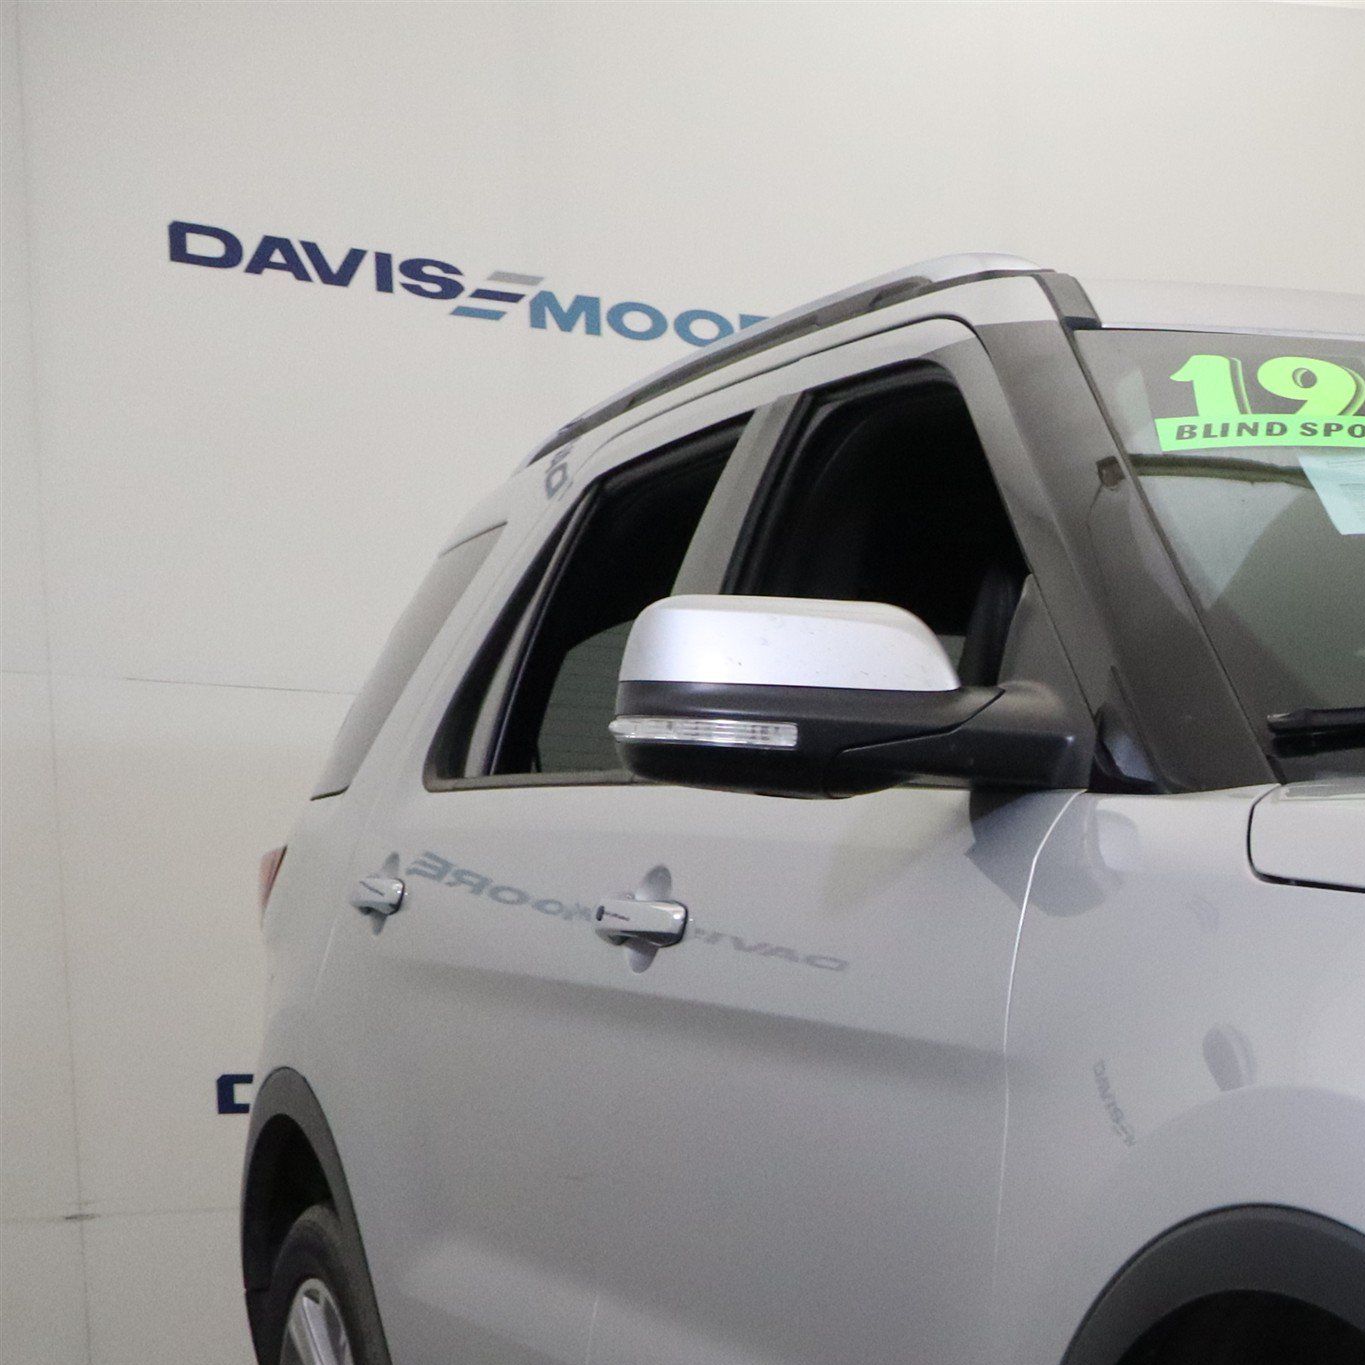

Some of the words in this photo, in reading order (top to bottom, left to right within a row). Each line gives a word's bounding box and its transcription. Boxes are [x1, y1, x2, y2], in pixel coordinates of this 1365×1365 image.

[167, 220, 466, 301] DAVIS
[529, 290, 770, 347] MOO
[1175, 421, 1289, 441] BLIND
